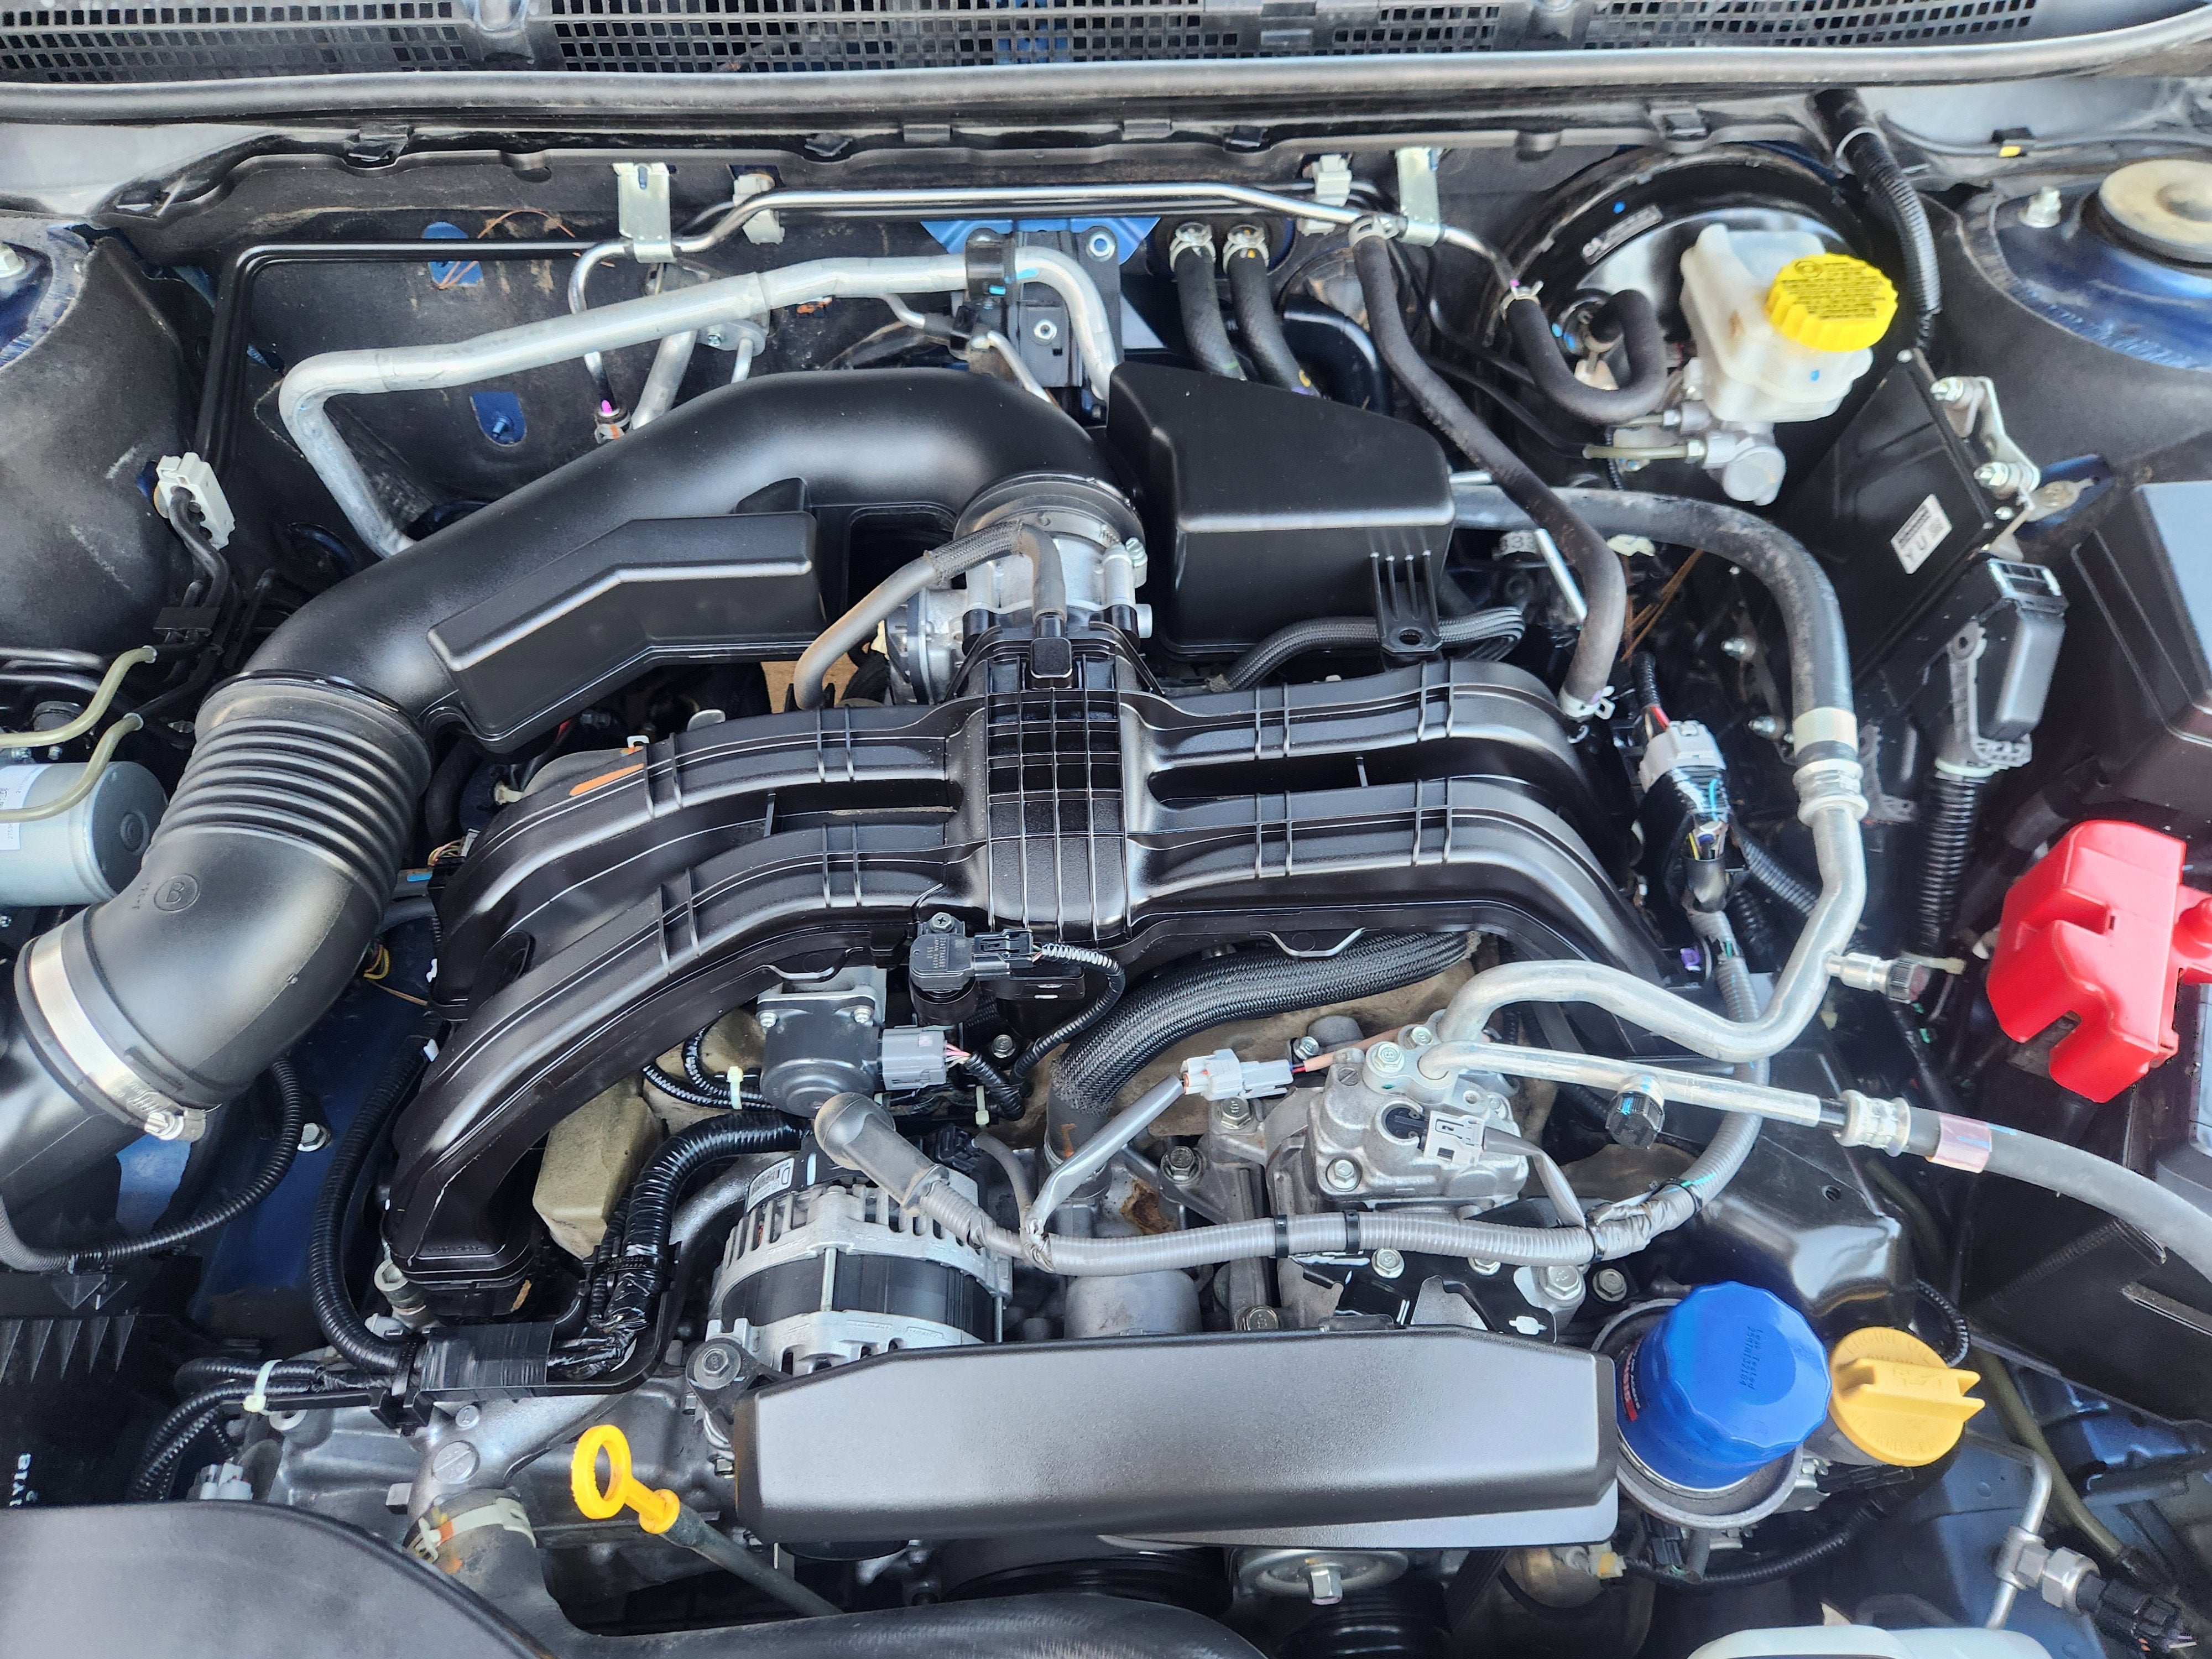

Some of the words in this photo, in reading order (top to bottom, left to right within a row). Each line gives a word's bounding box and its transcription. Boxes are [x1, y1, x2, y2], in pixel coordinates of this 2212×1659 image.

[166, 882, 184, 903] B
[1843, 1331, 1896, 1355] ENGINE
[1907, 1341, 1931, 1365] OIL
